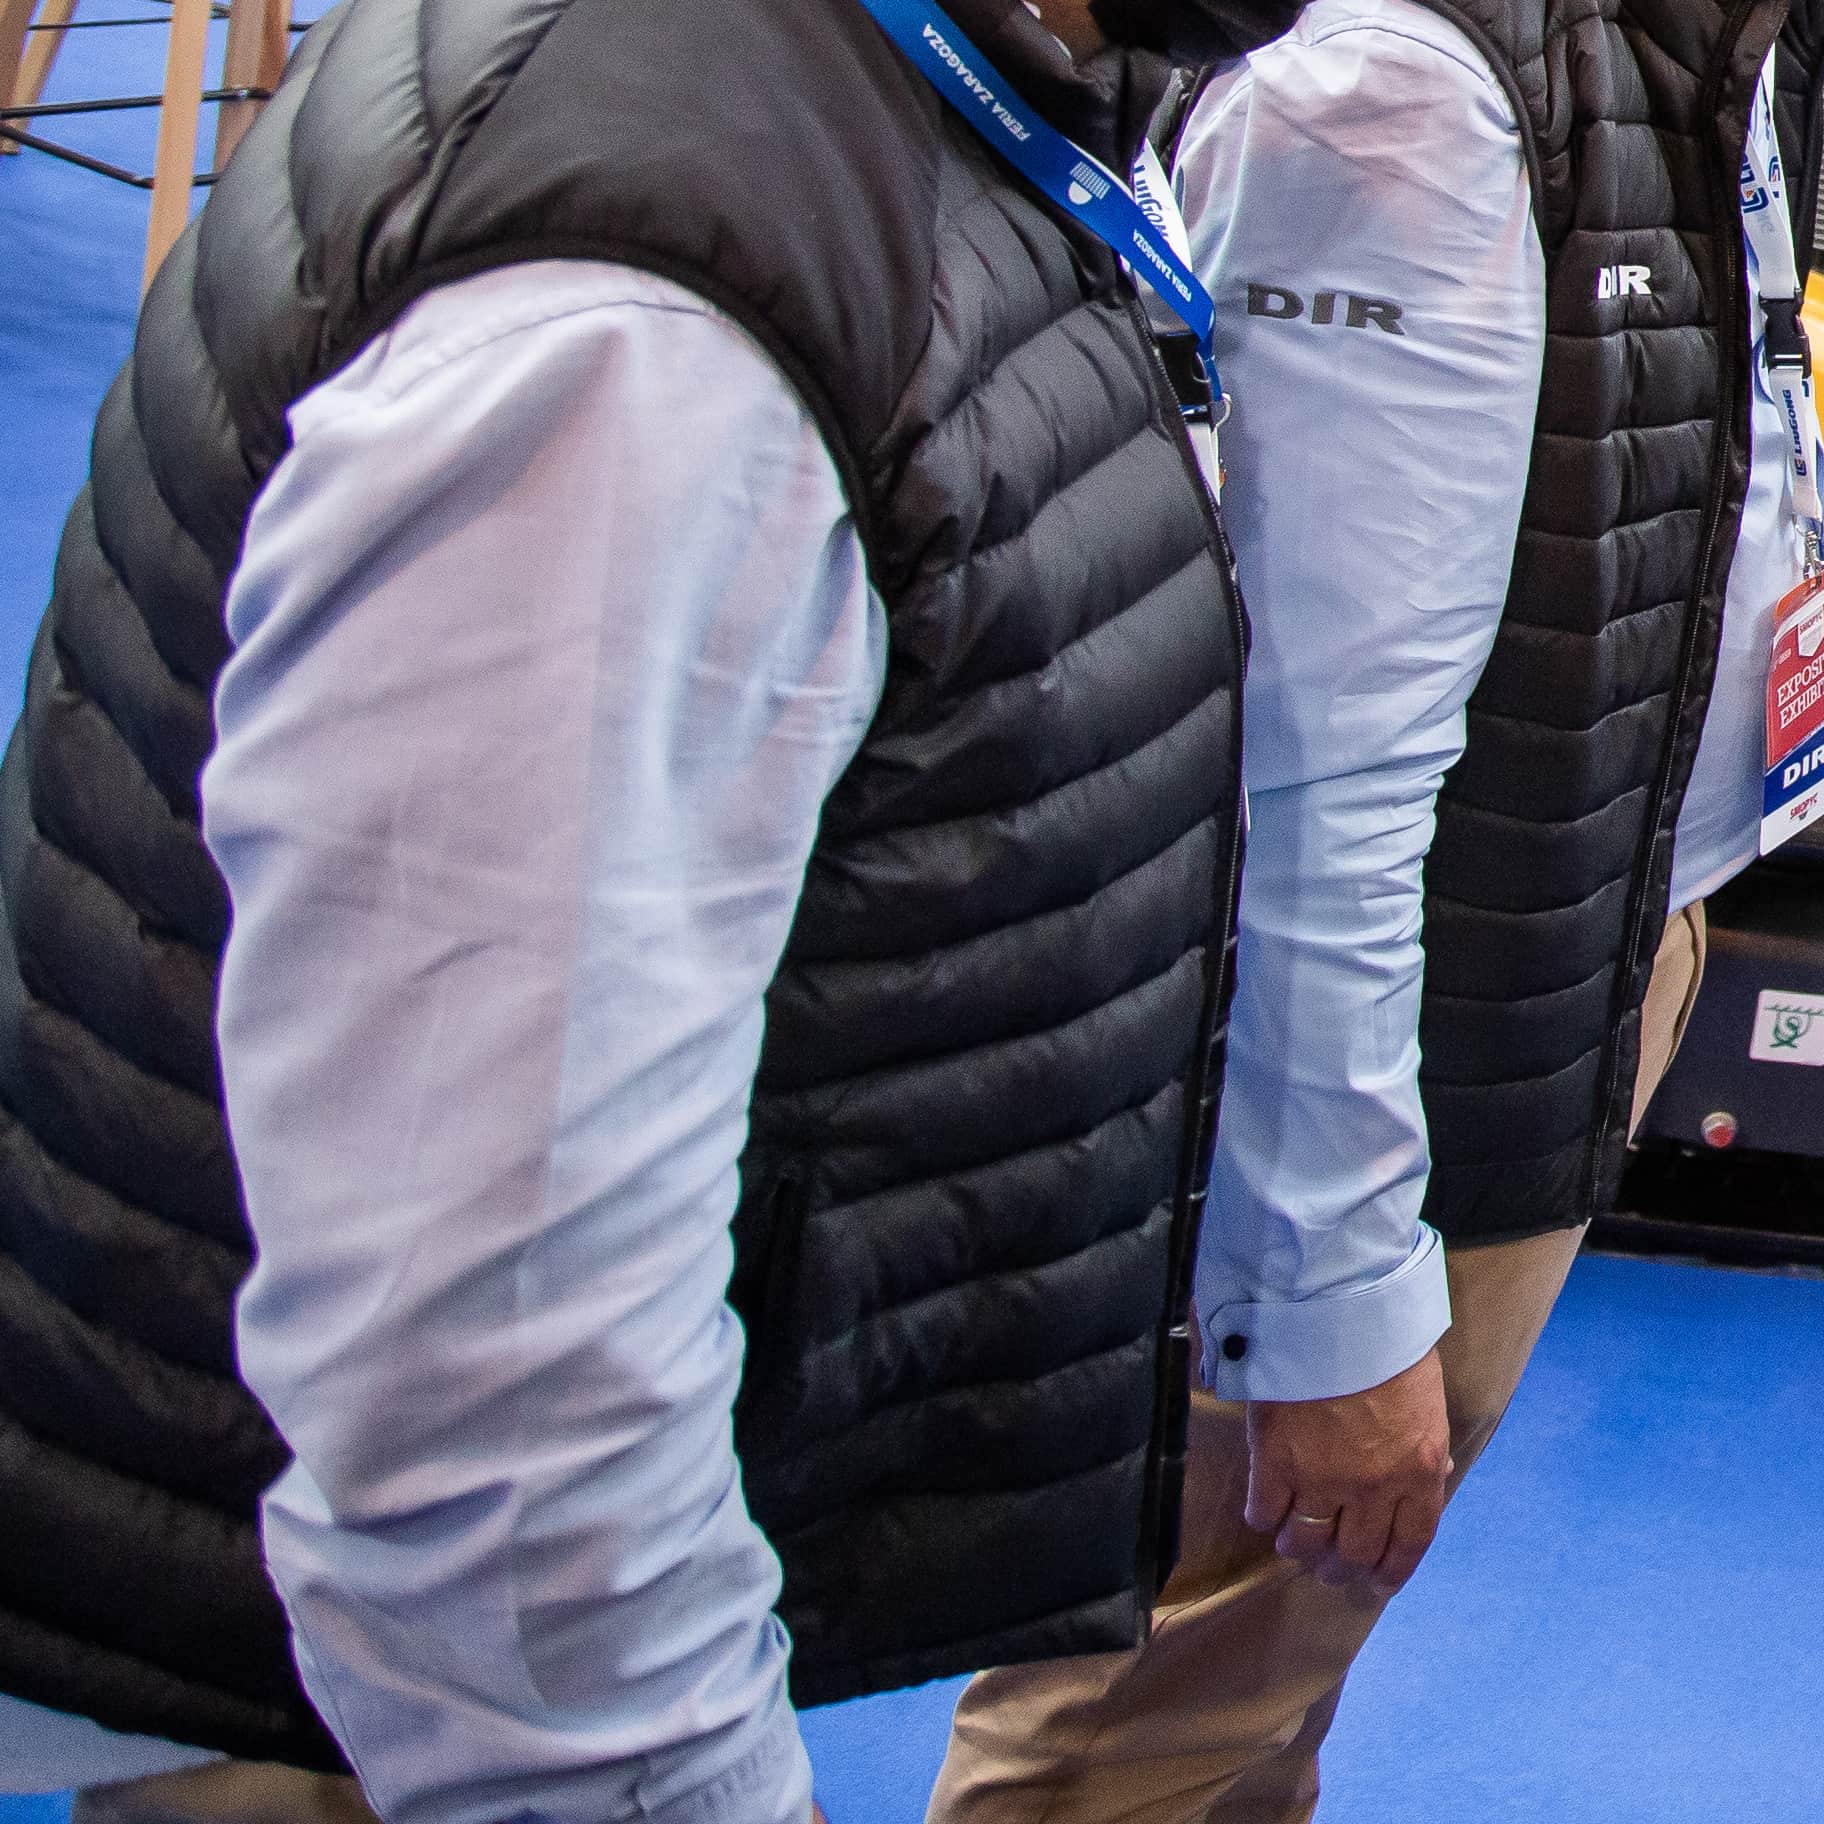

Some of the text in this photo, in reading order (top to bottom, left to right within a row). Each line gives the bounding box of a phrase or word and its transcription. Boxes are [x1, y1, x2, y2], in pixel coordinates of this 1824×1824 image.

[923, 23, 1031, 141] FERIA ZARAGOZA
[1247, 282, 1407, 336] DIR
[1598, 265, 1652, 300] DIR
